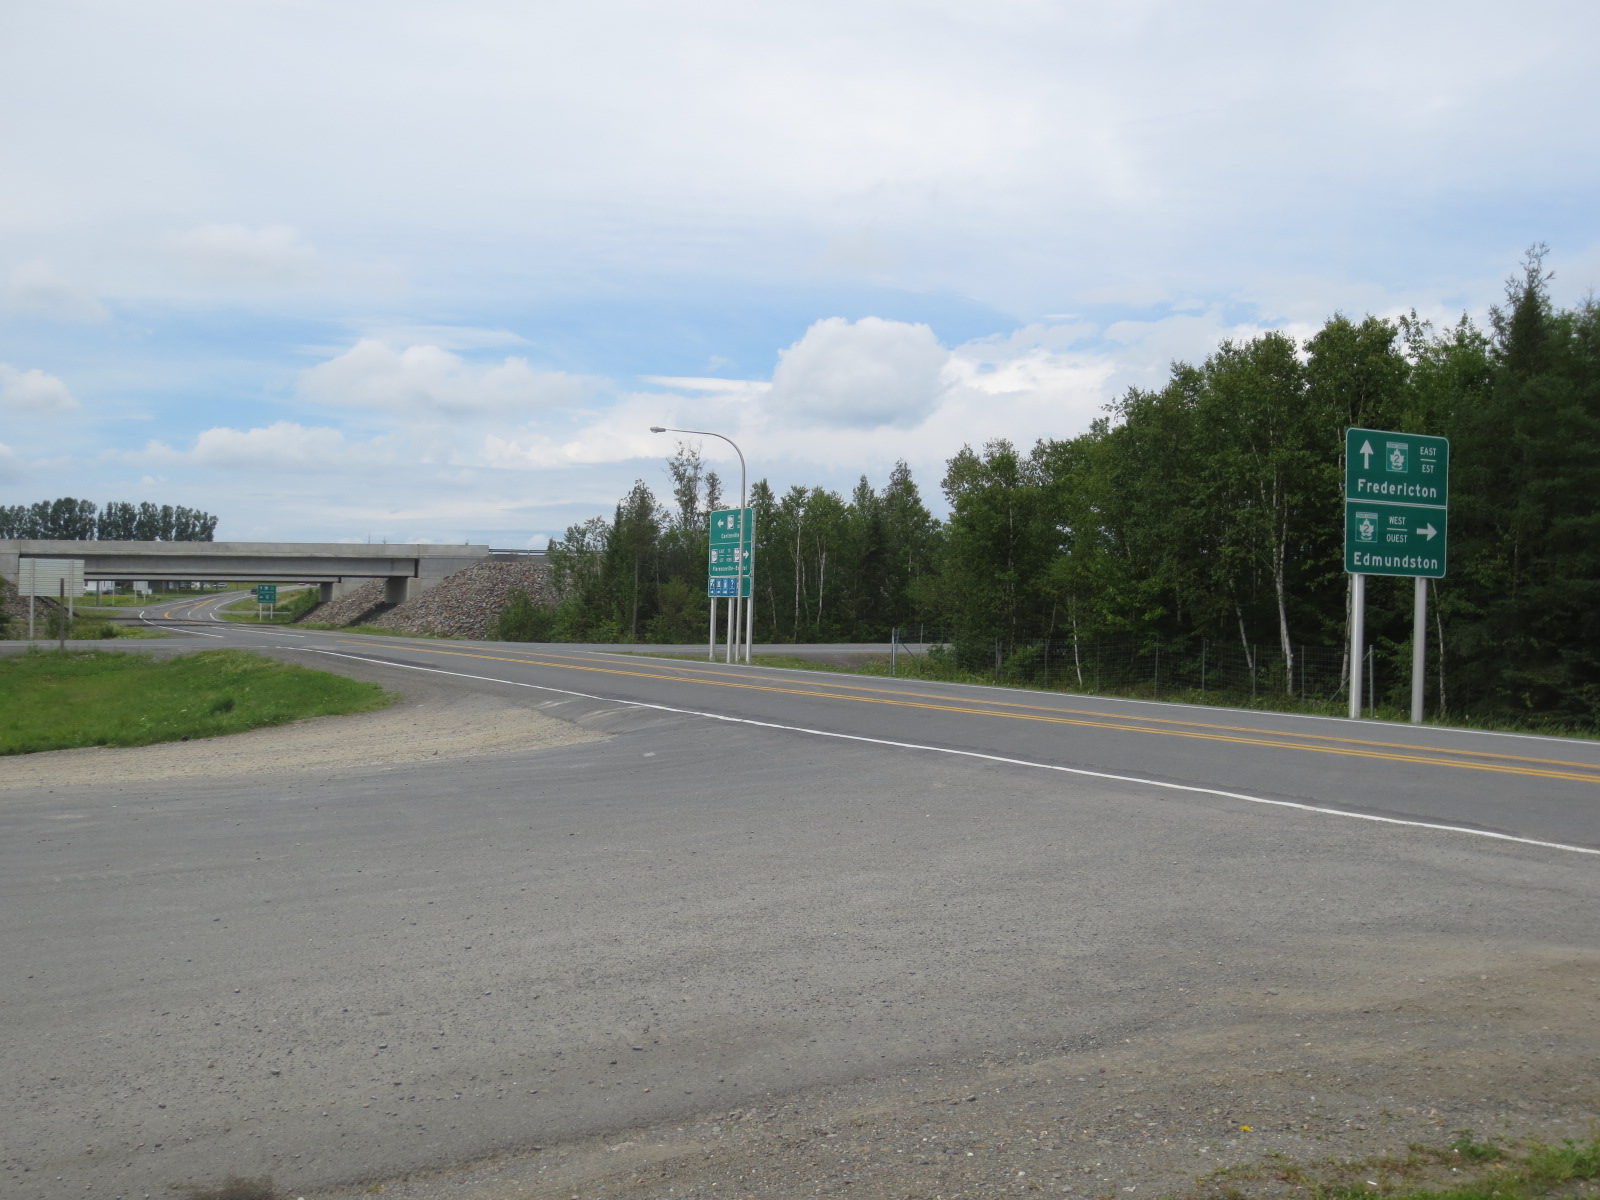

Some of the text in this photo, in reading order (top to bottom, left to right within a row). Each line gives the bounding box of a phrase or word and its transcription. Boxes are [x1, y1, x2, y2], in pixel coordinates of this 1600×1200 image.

[1393, 454, 1400, 464] 2
[1420, 446, 1437, 456] EAST
[1421, 464, 1435, 474] EST
[1357, 478, 1437, 498] Fredericton
[1363, 524, 1370, 534] 2
[1389, 515, 1406, 525] WEST
[1386, 534, 1408, 543] OUEST
[1353, 551, 1438, 569] Edmundston
